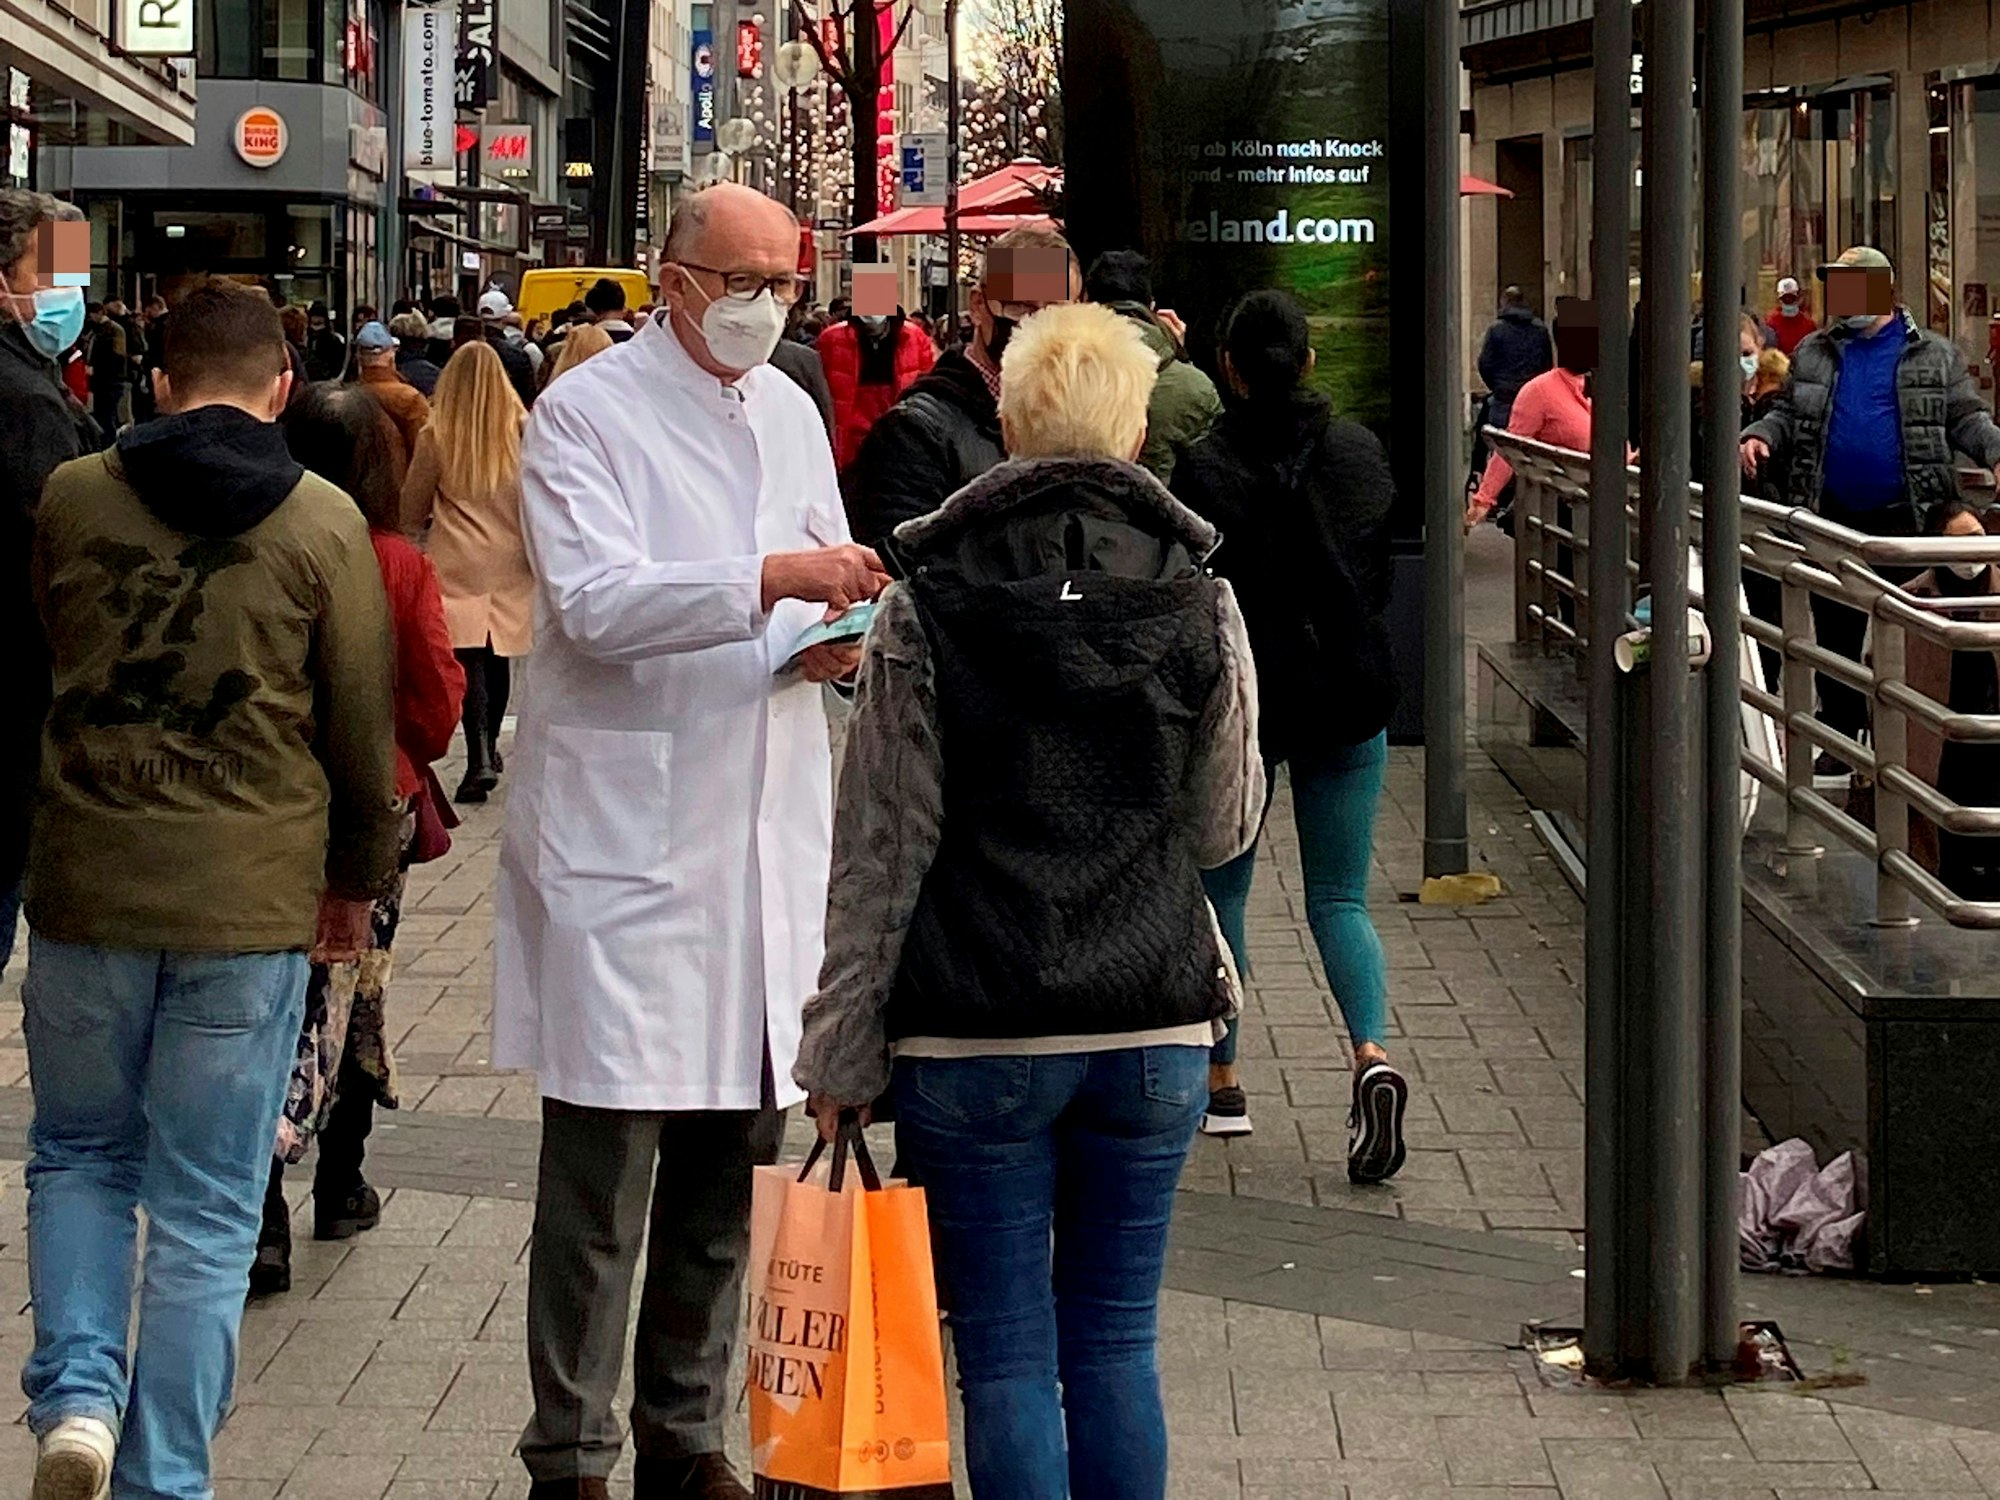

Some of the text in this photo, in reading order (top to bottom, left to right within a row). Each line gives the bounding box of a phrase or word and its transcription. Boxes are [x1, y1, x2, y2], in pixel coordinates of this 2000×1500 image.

[420, 12, 434, 166] blue-tomato.com
[698, 83, 714, 130] Apollo
[244, 136, 278, 149] KING
[1204, 142, 1226, 157] ab
[1232, 140, 1273, 157] Köln
[1277, 140, 1322, 157] nach
[1325, 140, 1384, 157] Knock
[1237, 166, 1286, 183] mehr
[1288, 165, 1336, 183] Infos
[1338, 166, 1370, 183] auf
[778, 1259, 824, 1284] TÜTE
